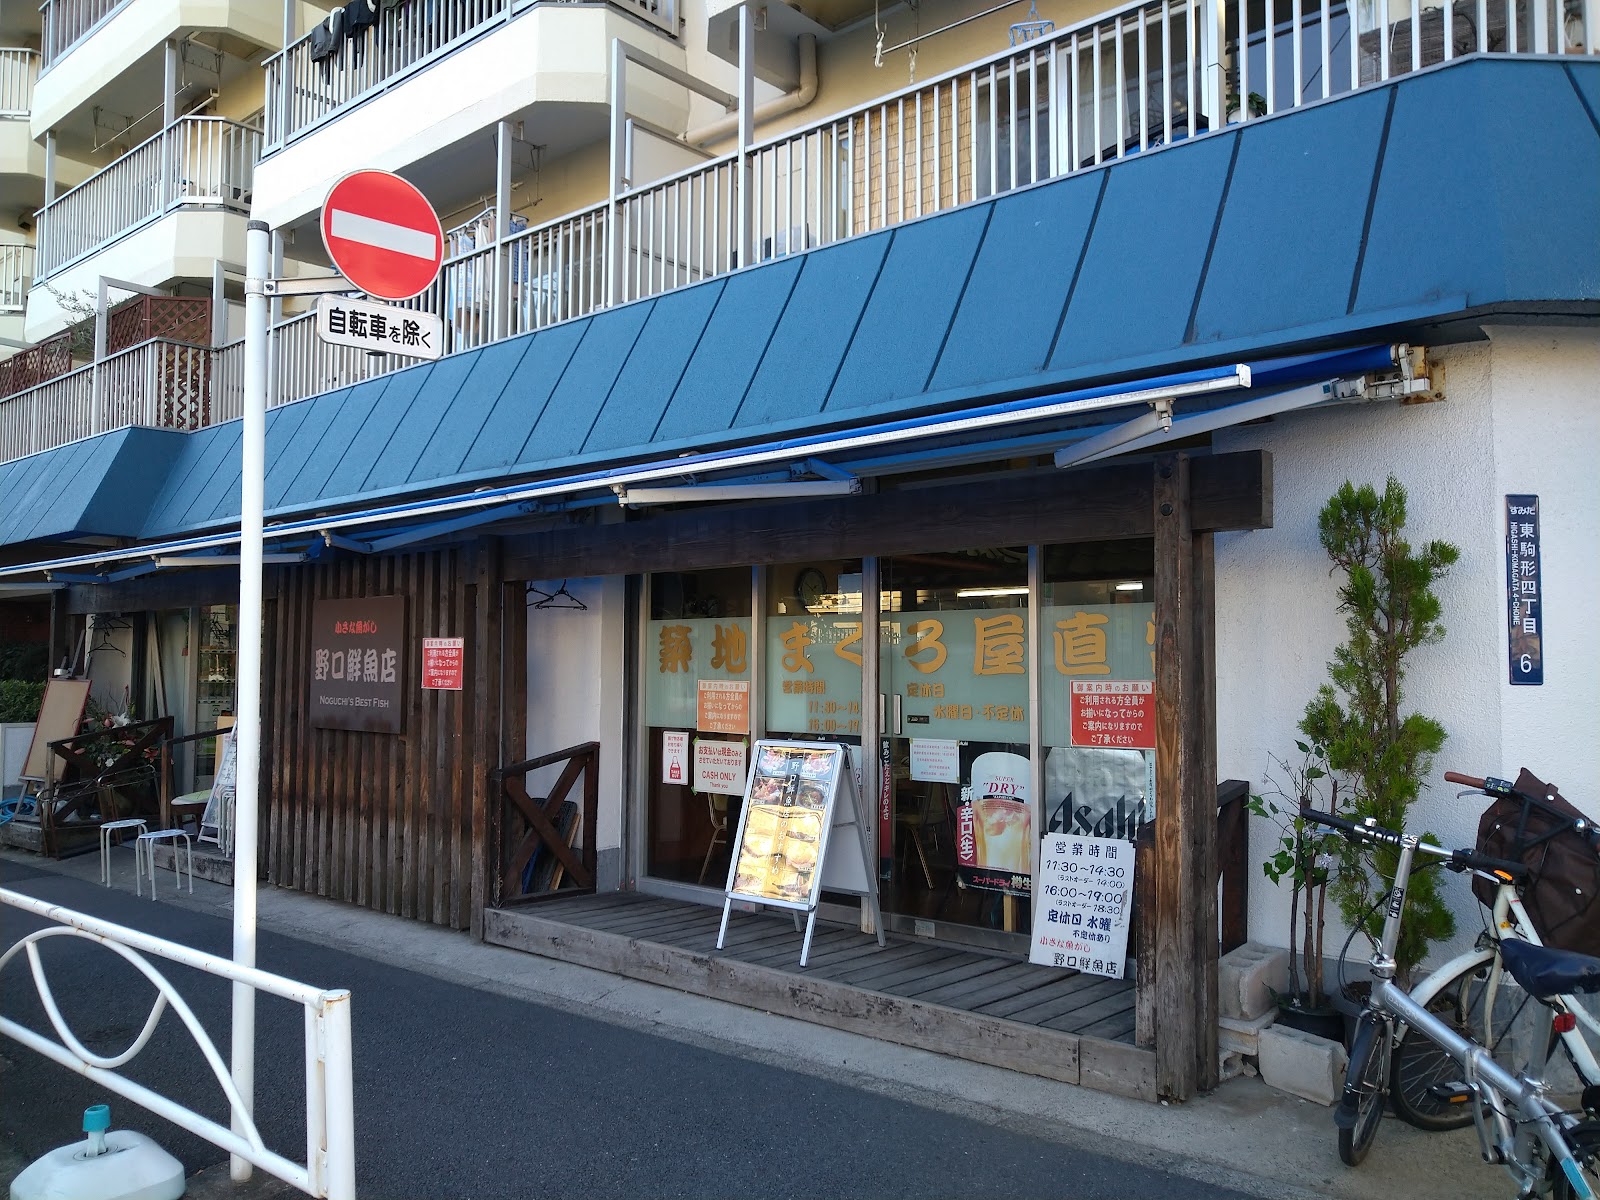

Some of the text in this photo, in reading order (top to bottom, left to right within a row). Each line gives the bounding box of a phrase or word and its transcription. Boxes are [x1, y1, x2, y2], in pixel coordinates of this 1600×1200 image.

[329, 306, 431, 349] 自転車を除く
[1510, 506, 1536, 515] すみだ
[1510, 521, 1520, 625] HIGASHI-KOMAGATA 4-CHOME
[1519, 522, 1537, 634] 東駒形四丁目
[314, 648, 397, 683] 野口鮮魚店
[1520, 653, 1532, 673] 6
[782, 680, 826, 694] 営業時間
[907, 681, 945, 698] 定休日
[1076, 683, 1149, 692] 御案内時のお願い
[354, 696, 372, 707] BEST
[373, 698, 389, 708] FISH
[1080, 695, 1145, 706] ご利用される方全員が
[1081, 707, 1144, 718] お揃いになってからの
[1082, 720, 1143, 731] ご案内になりますので
[1091, 734, 1134, 744] ご了承ください
[698, 746, 742, 758] お支払いは現金のみと
[702, 770, 737, 781] CASH ONLY
[1055, 841, 1118, 860] 営業時間
[1048, 909, 1112, 932] 定休日 水曜
[1040, 935, 1091, 953] 小さな魚がし
[1072, 929, 1111, 944] 不定休あり
[1053, 952, 1118, 975] 野口鮮魚店
